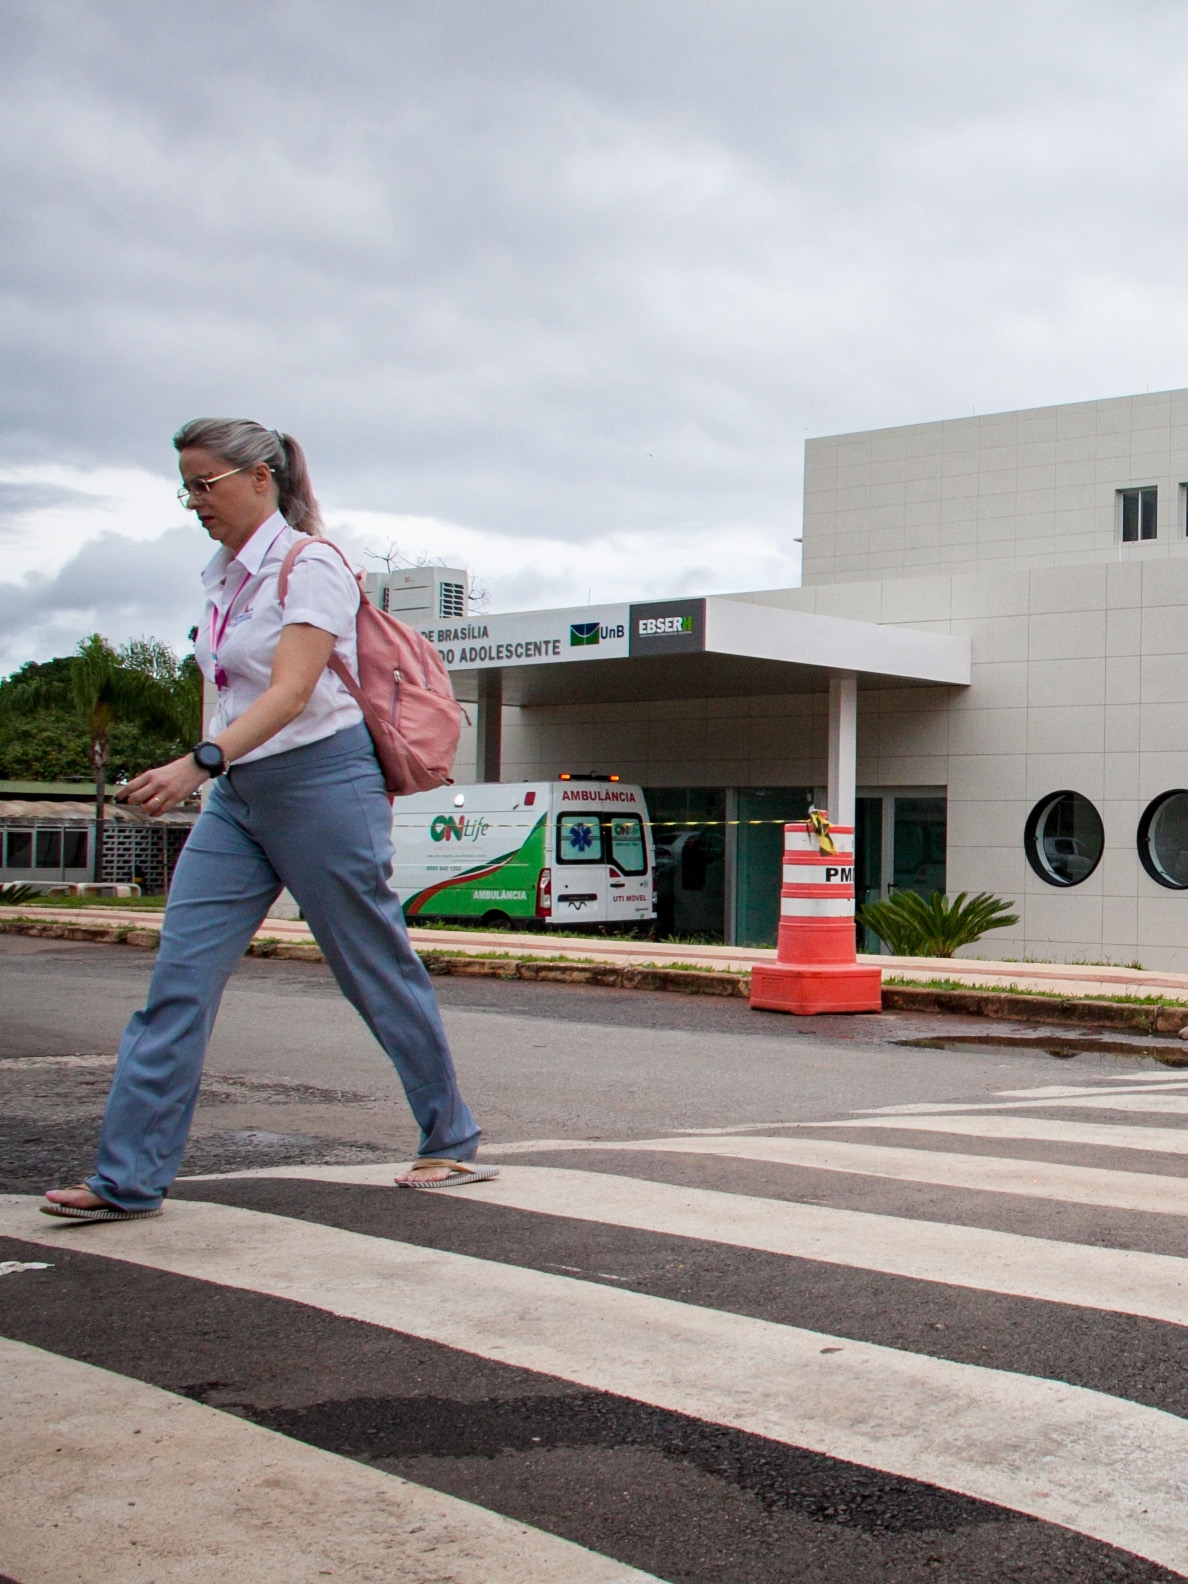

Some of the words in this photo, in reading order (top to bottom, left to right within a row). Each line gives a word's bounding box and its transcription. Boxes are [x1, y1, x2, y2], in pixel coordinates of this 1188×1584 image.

[437, 624, 489, 642] BRASÍLIA
[600, 625, 625, 640] UnB
[638, 616, 692, 635] EBSERH
[459, 639, 561, 663] ADOLESCENTE
[562, 789, 636, 803] AMBULÂNCIA
[826, 867, 855, 883] PM
[473, 890, 527, 900] AMBULÂNCIA
